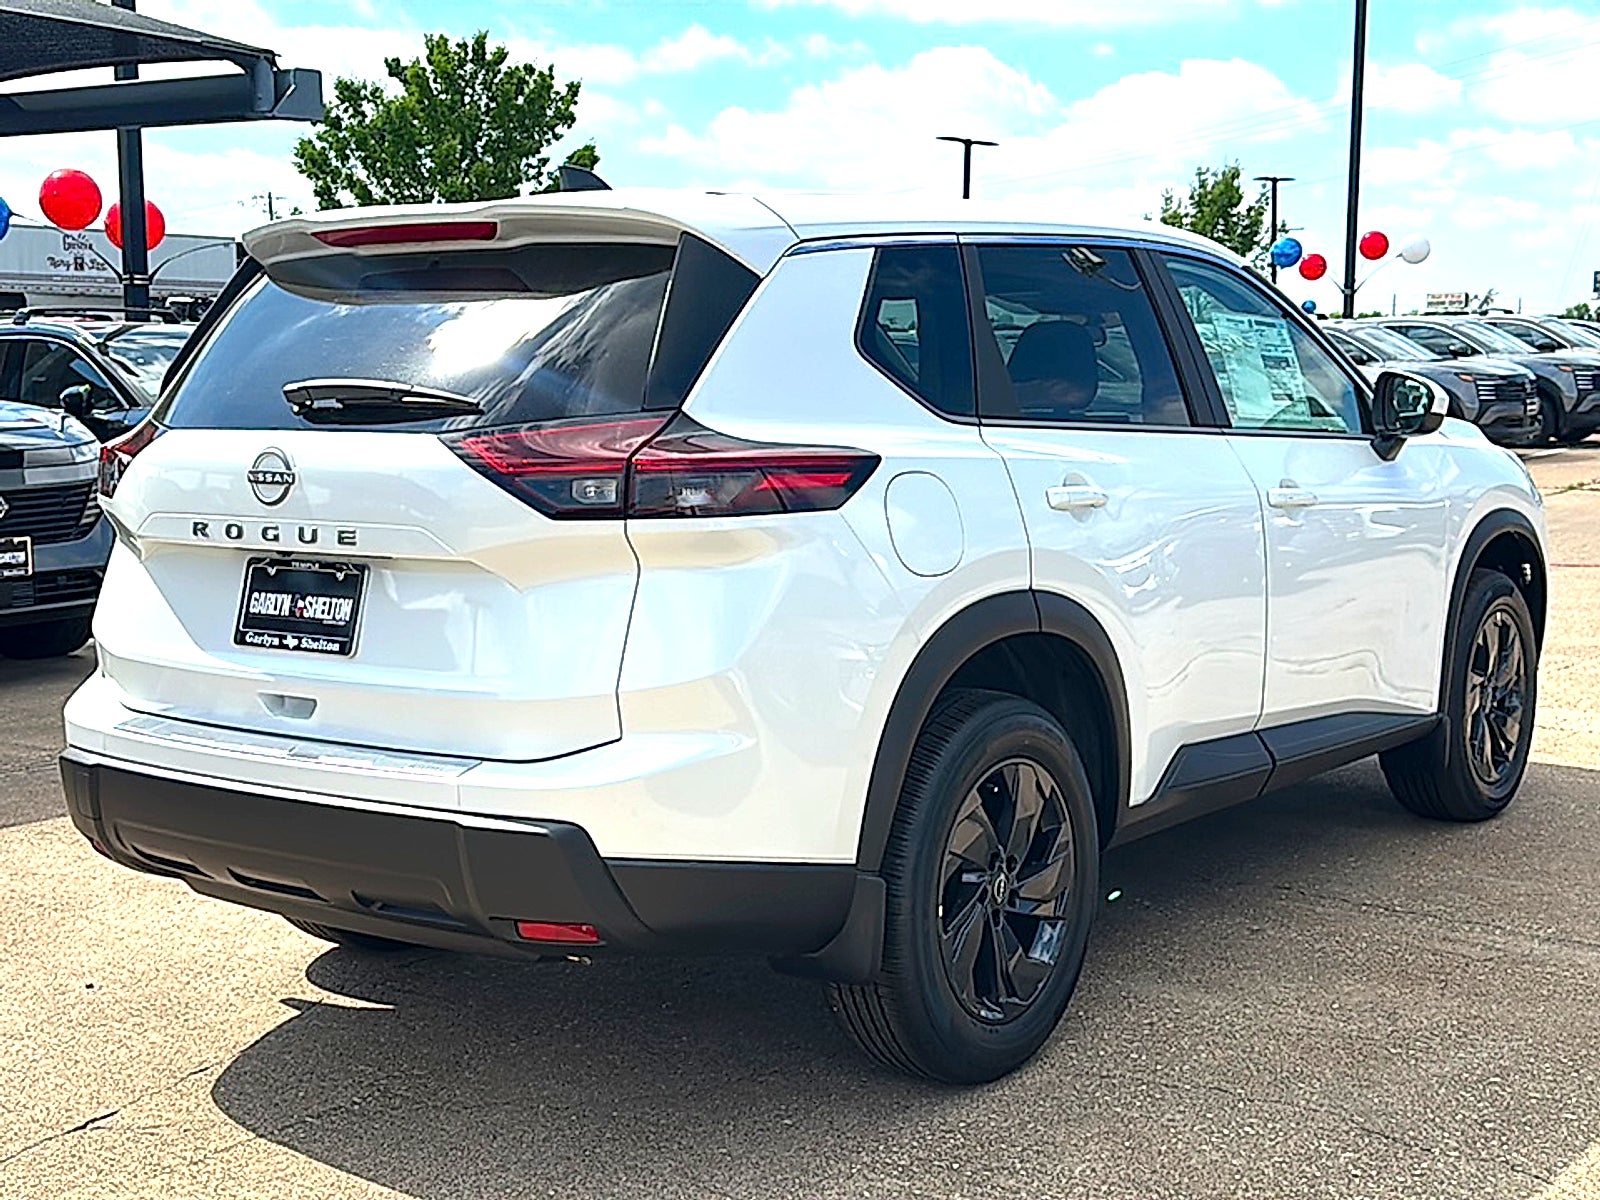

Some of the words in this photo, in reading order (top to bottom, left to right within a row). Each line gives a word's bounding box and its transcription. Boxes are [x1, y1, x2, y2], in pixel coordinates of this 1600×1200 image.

[247, 472, 293, 483] NISSAN
[192, 521, 357, 546] ROGUE
[249, 592, 292, 616] GARLYN
[303, 596, 354, 621] SHELTON
[245, 631, 280, 647] Garlyn
[300, 637, 340, 652] Shelton
